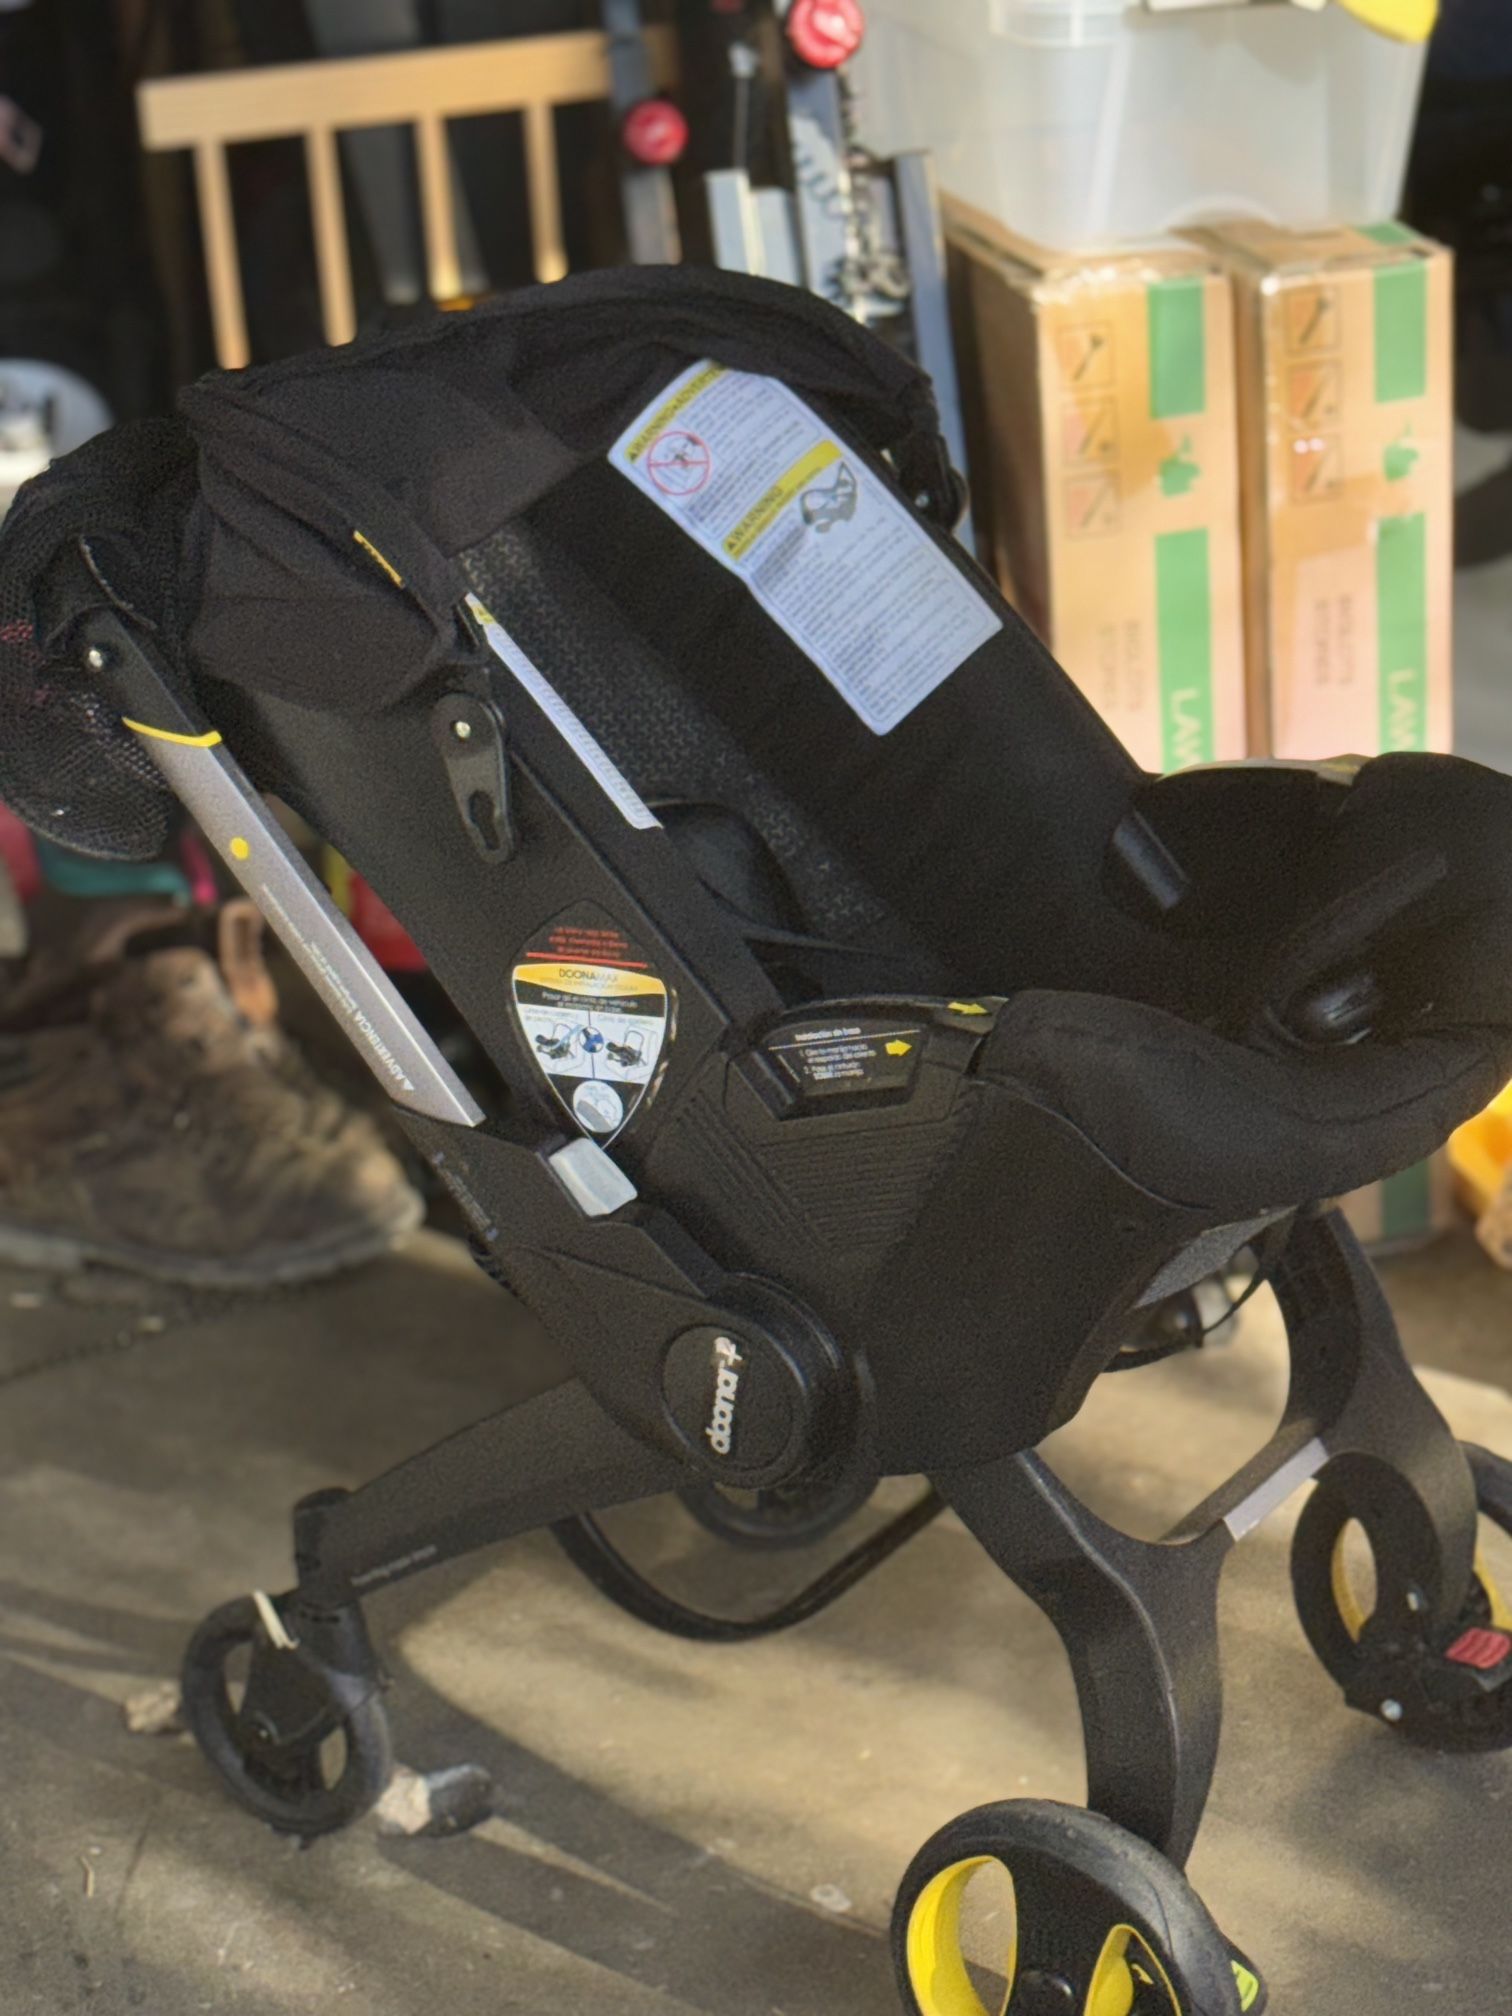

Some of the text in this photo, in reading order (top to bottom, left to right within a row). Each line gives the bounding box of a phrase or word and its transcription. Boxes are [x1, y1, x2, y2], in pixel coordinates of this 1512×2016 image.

[728, 484, 783, 542] WARNING
[353, 1011, 406, 1080] ADVERTENCIA
[705, 1365, 739, 1454] doona
